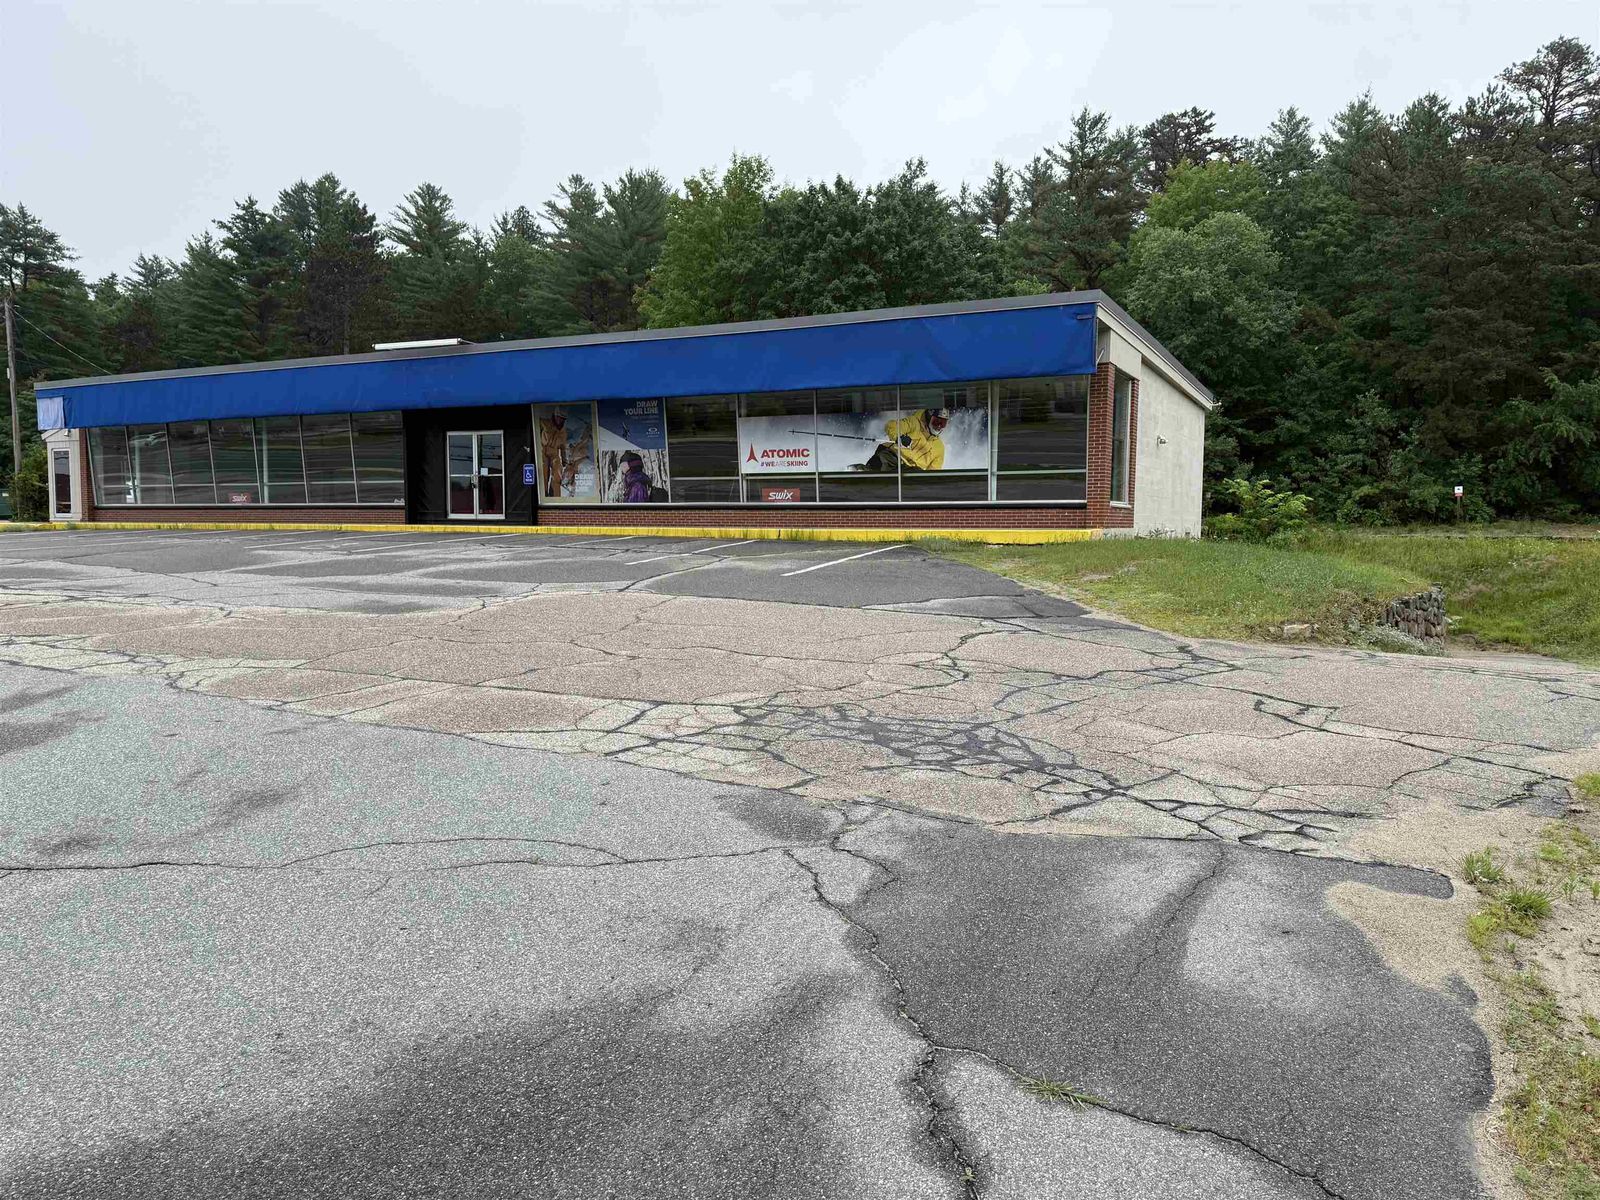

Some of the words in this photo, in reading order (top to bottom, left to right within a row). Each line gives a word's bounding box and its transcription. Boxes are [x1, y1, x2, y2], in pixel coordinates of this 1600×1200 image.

[636, 400, 658, 408] DRAW
[624, 407, 643, 415] YOUR
[644, 406, 659, 414] LINE
[761, 448, 810, 459] ATOMIC
